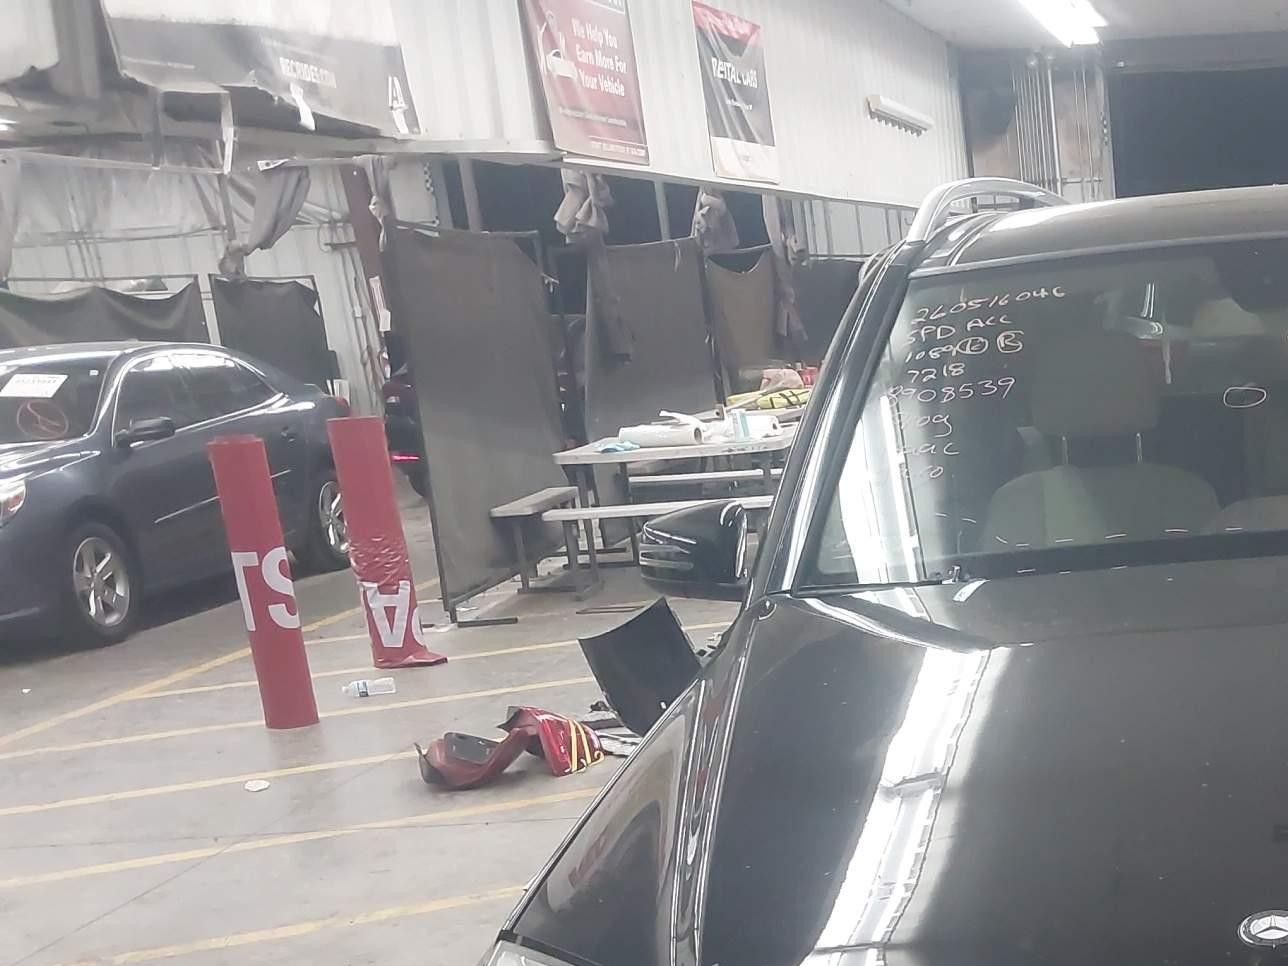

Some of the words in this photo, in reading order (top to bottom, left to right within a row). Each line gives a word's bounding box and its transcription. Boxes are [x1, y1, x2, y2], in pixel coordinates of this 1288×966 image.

[585, 23, 603, 48] Help
[603, 28, 618, 49] You
[575, 44, 594, 65] Earn
[594, 48, 615, 71] More
[615, 55, 627, 74] For
[579, 68, 598, 90] Your
[598, 73, 625, 97] Vehicle
[907, 363, 966, 384] 7218
